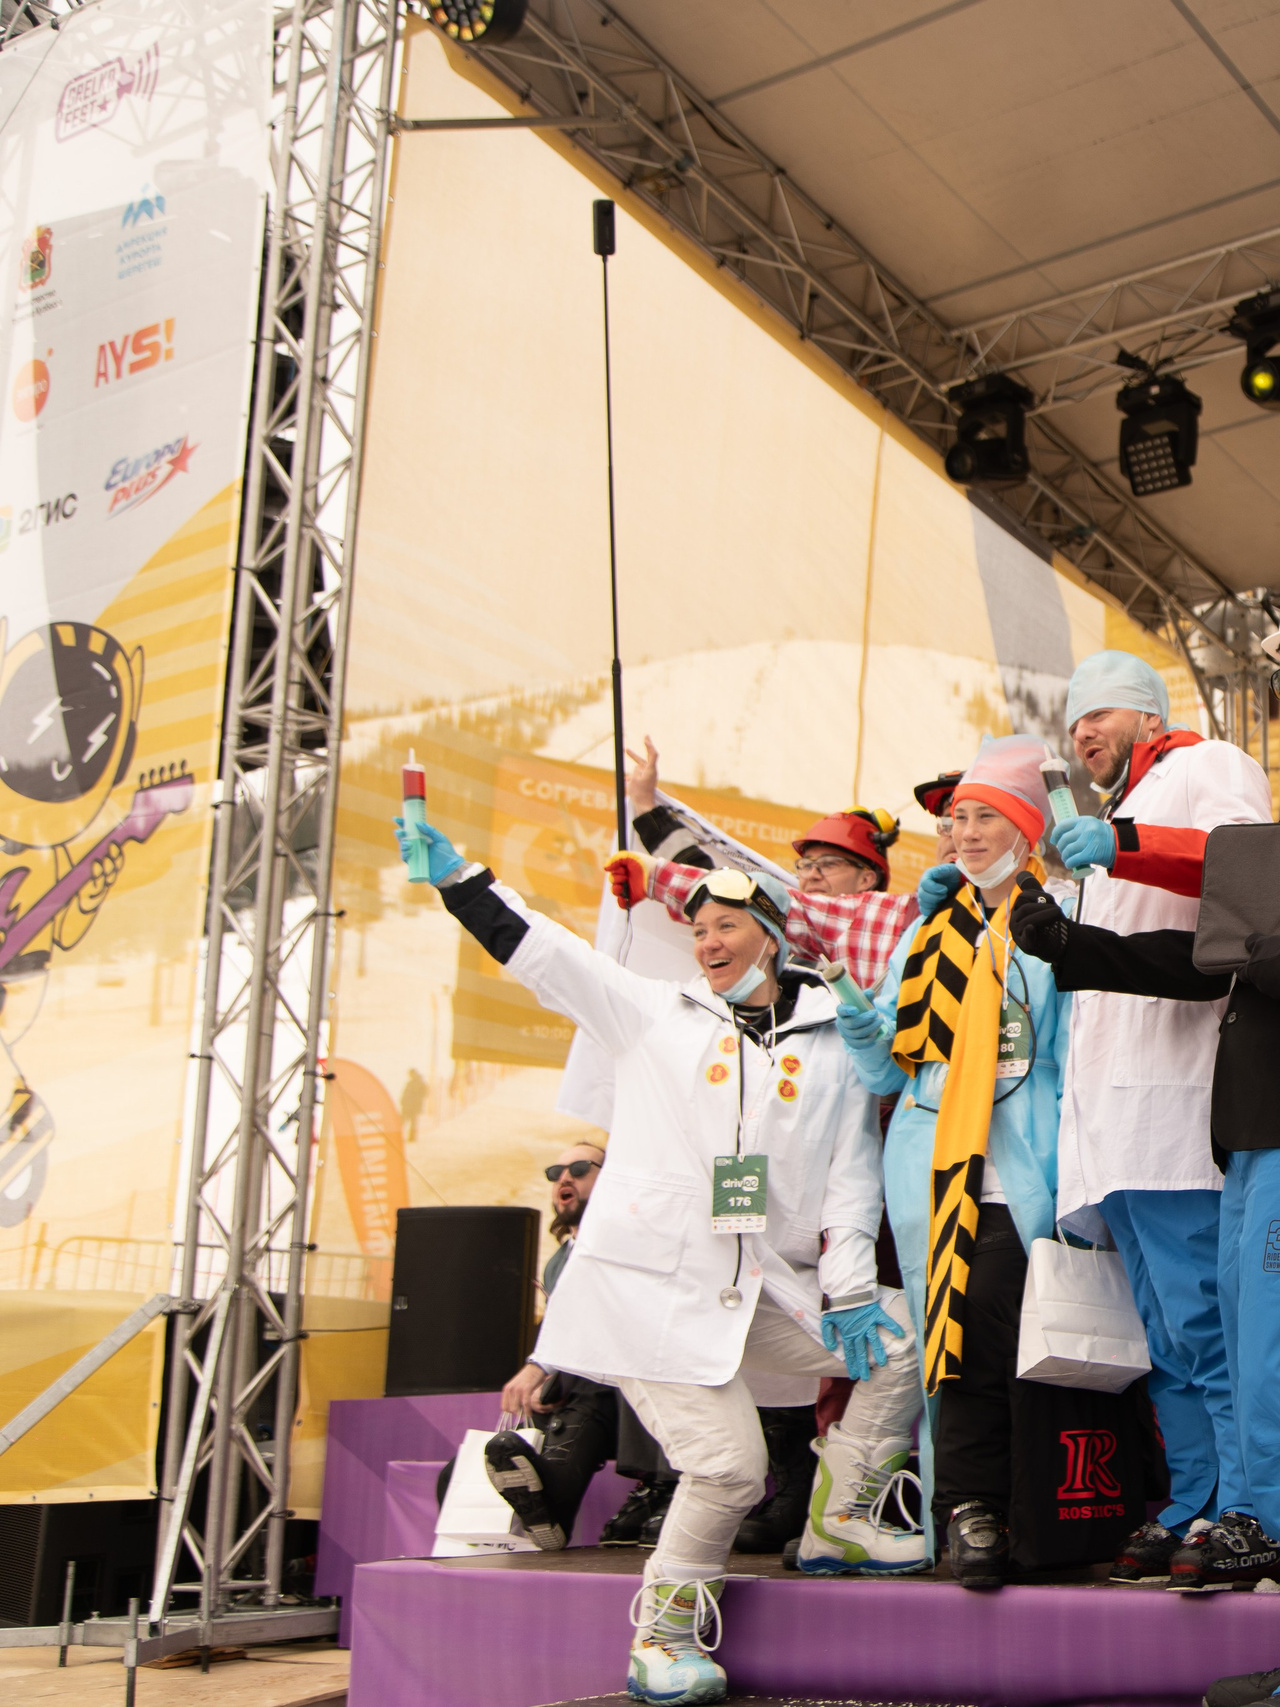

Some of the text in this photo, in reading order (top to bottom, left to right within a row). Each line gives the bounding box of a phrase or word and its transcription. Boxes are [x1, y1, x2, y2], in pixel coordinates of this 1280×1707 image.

[94, 318, 175, 388] AYS!
[19, 493, 78, 535] 2ГИС
[728, 1196, 752, 1207] 176
[1057, 1430, 1121, 1499] R
[1058, 1503, 1125, 1520] ROSTIC'S
[1213, 1551, 1277, 1569] salomon
